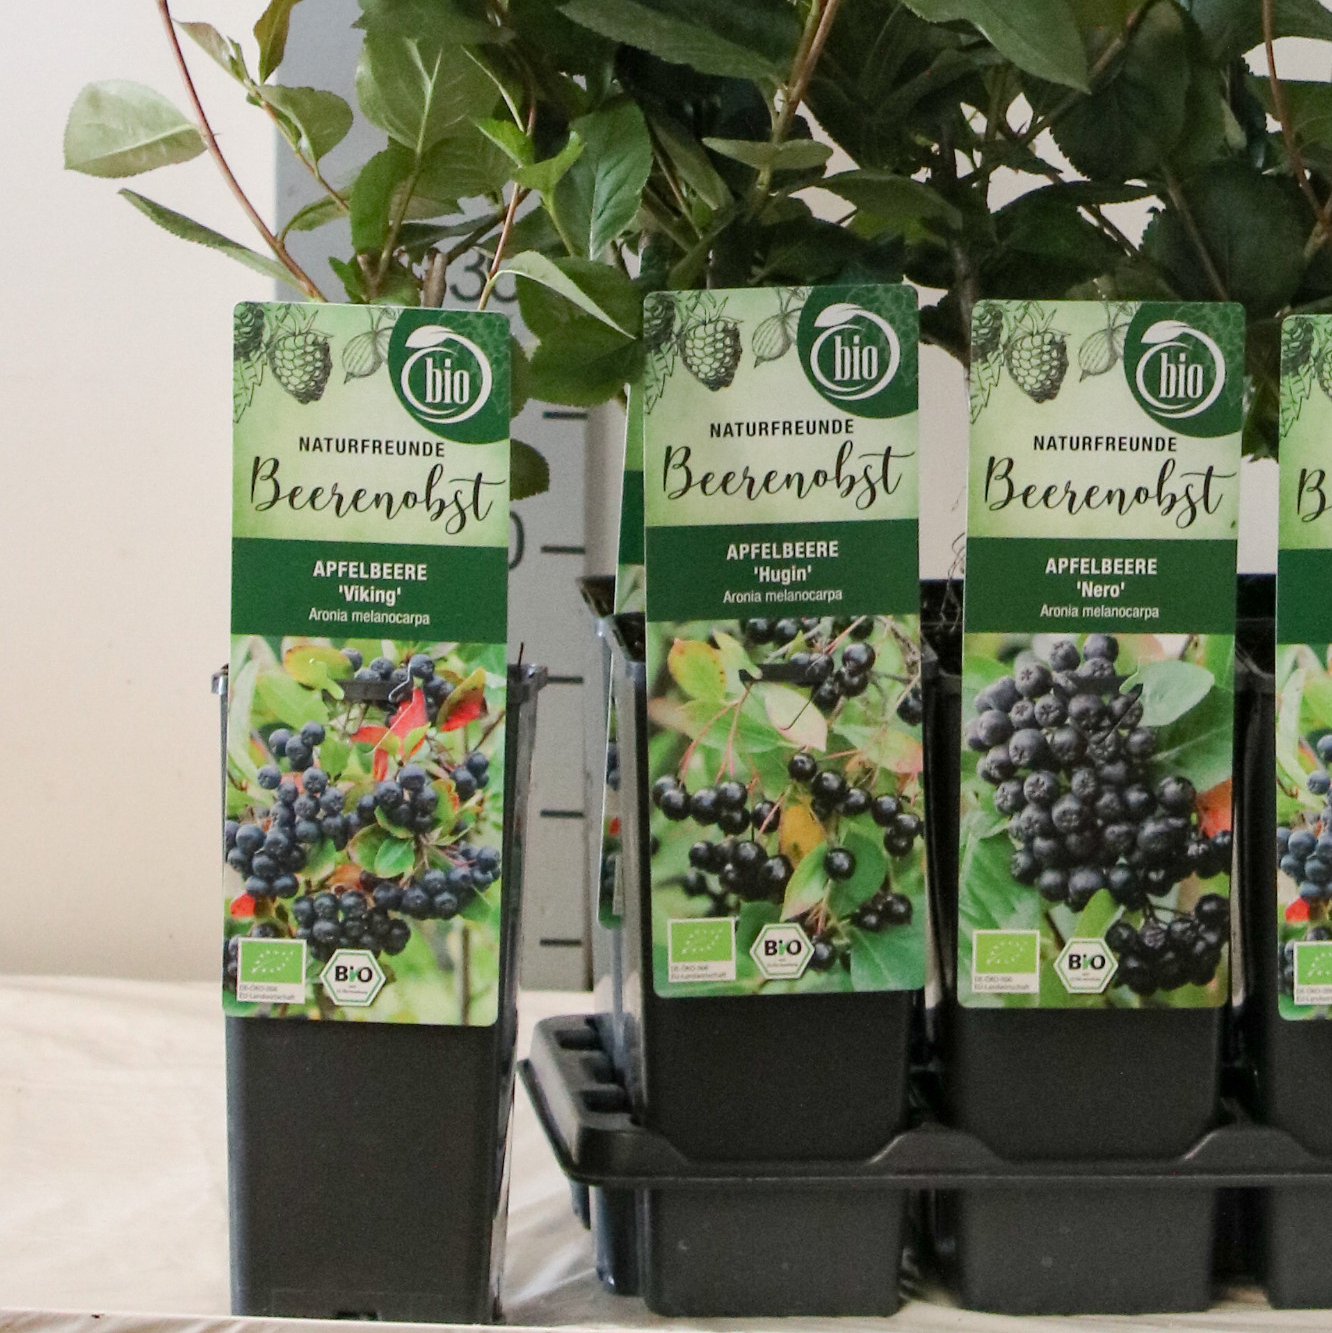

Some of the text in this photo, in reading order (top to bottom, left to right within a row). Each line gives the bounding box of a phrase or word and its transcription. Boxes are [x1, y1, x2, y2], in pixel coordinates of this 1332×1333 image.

[834, 336, 877, 380] bio
[425, 357, 469, 404] bio
[1159, 353, 1203, 398] bio
[711, 419, 853, 437] NATURFREUNDE
[300, 436, 445, 457] NATURFREUNDE
[1034, 436, 1176, 451] NATURFREUNDE
[663, 440, 914, 509] Beerenobst
[251, 456, 505, 534] Beerenobst
[985, 456, 1235, 528] Beerenobst
[727, 541, 838, 560] APFELBEERE
[313, 561, 427, 580] APFELBEERE
[754, 565, 811, 584] 'Hugin'
[1046, 558, 1157, 574] APFELBEERE
[339, 585, 401, 606] 'Viking'
[723, 589, 842, 603] Aronia melanocarpa
[1077, 581, 1124, 597] 'Nero'
[309, 608, 430, 626] Aronia melanocarpa
[1040, 605, 1159, 620] Aronia melanocarpa
